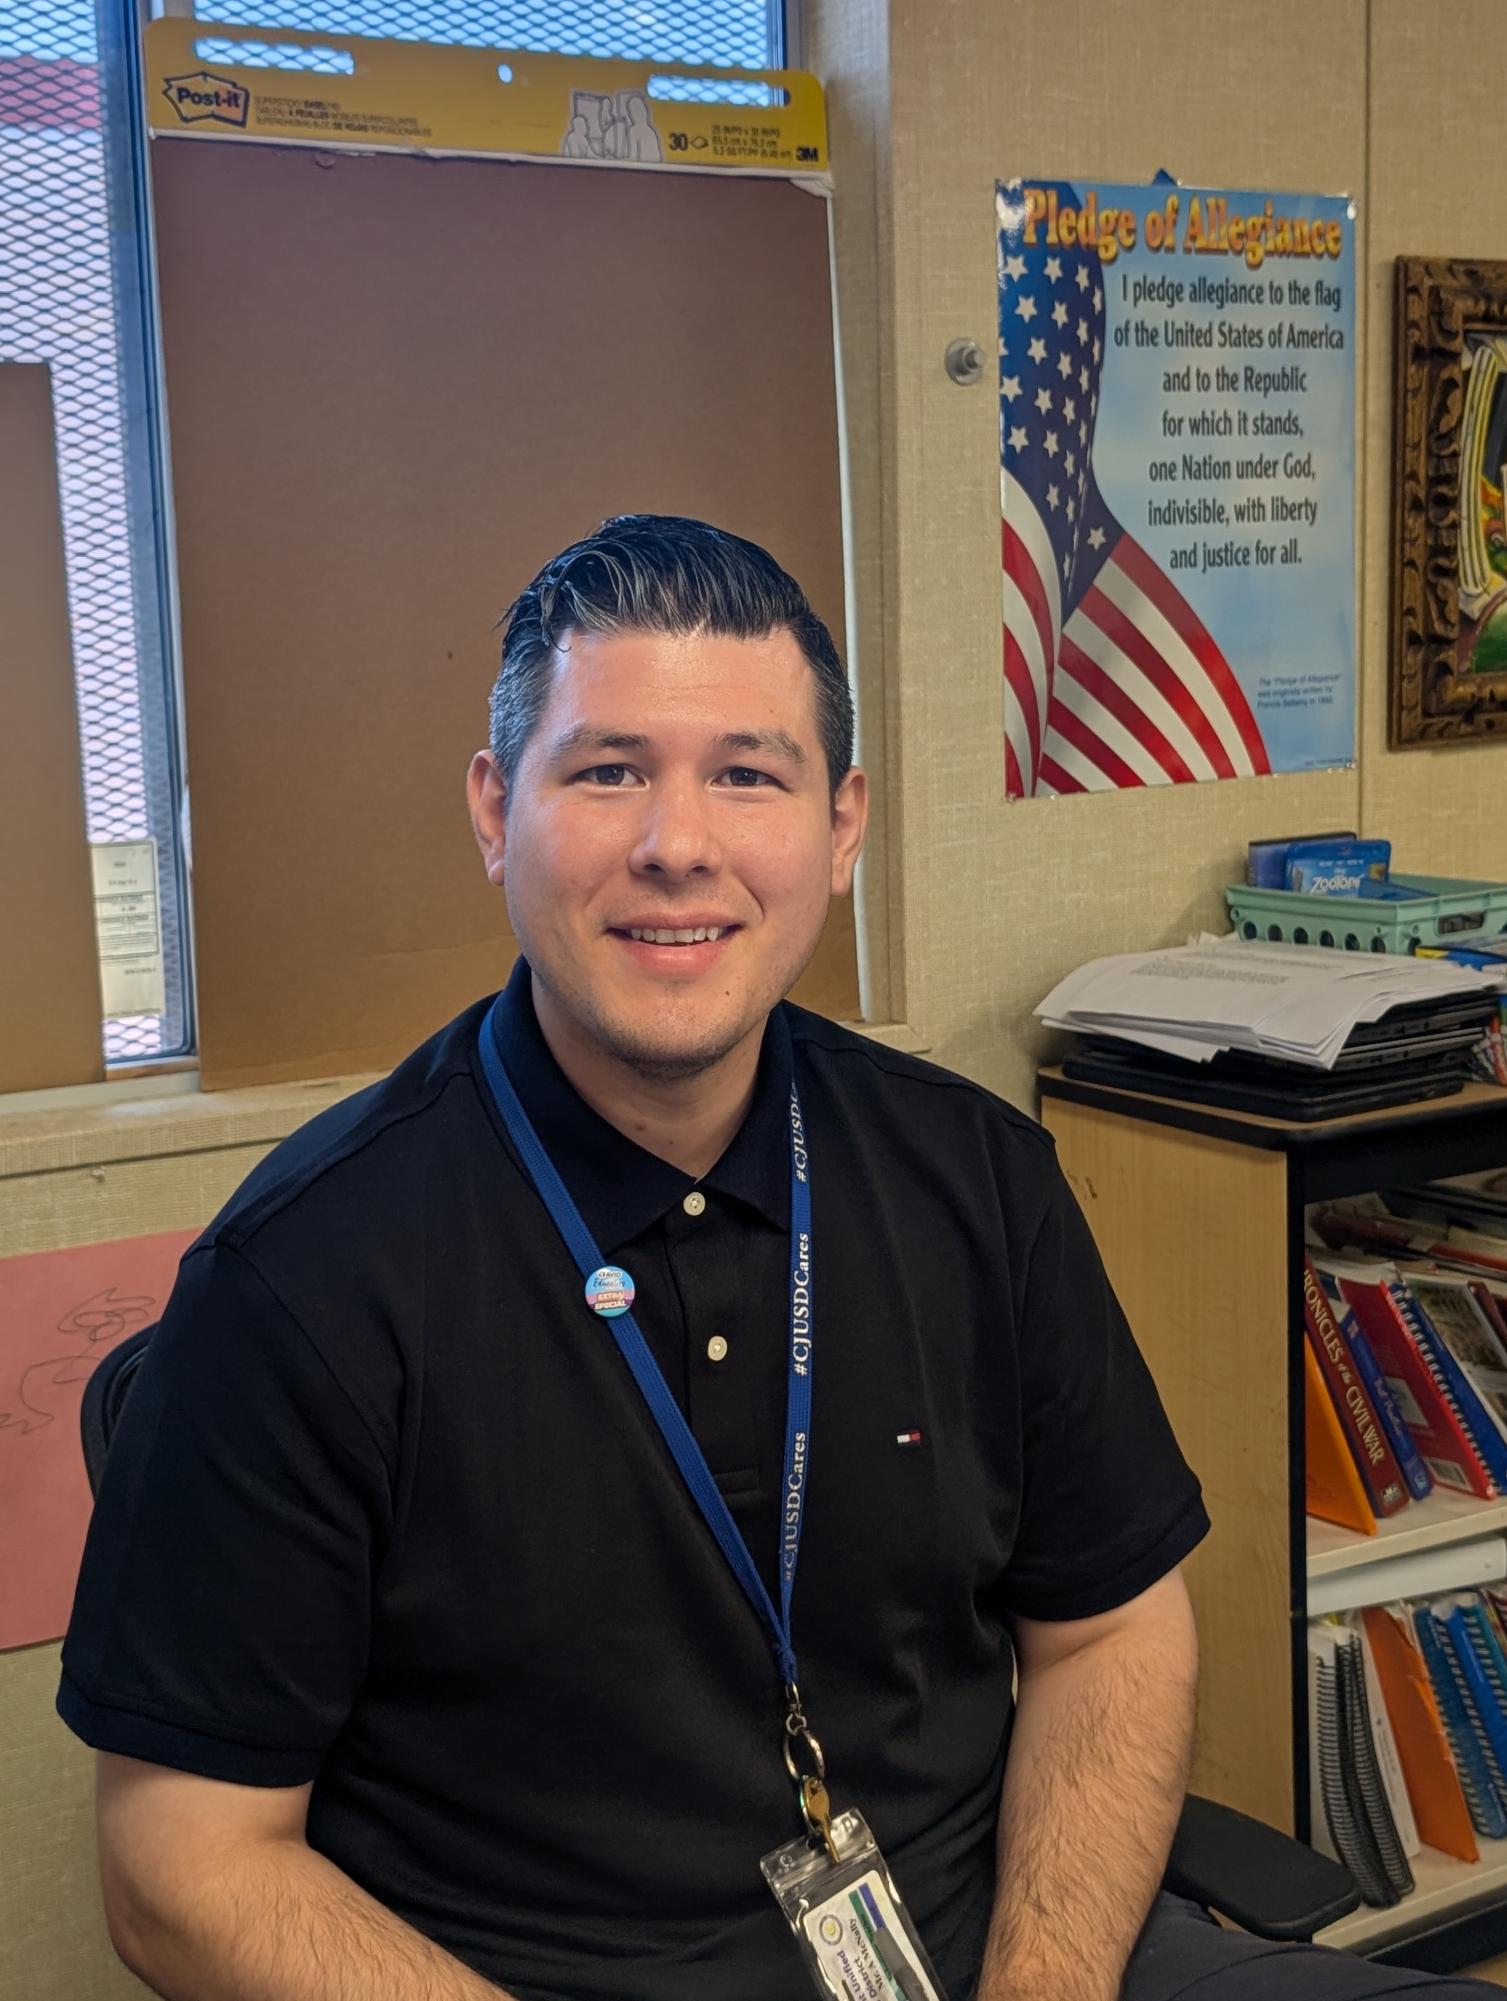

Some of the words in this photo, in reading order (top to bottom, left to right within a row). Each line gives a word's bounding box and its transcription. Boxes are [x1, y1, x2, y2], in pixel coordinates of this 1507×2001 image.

[177, 86, 242, 109] Post-it
[669, 133, 687, 150] 30
[796, 146, 818, 161] 3M
[1022, 188, 1137, 265] Pledge
[1145, 194, 1179, 249] of
[1183, 192, 1343, 269] Allegiance
[1122, 274, 1127, 301] I
[1132, 275, 1184, 307] pledge
[1189, 276, 1264, 309] allegiance
[1268, 282, 1284, 304] to
[1288, 279, 1311, 304] the
[1314, 280, 1342, 311] flag
[1114, 320, 1131, 347] of
[1135, 320, 1159, 347] the
[1164, 321, 1213, 348] United
[1217, 322, 1263, 348] States
[1268, 322, 1284, 348] of
[1286, 324, 1344, 350] America
[1163, 366, 1190, 392] and
[1196, 370, 1211, 392] to
[1215, 366, 1240, 392] the
[1244, 366, 1308, 398] Republic
[1162, 410, 1184, 436] for
[1189, 410, 1233, 436] which
[1237, 410, 1249, 436] it
[1252, 410, 1304, 438] stands,
[1149, 460, 1177, 481] one
[1182, 453, 1231, 481] Nation
[1236, 453, 1279, 479] under
[1283, 452, 1316, 482] God,
[1148, 498, 1230, 527] indivisible,
[1234, 497, 1267, 523] with
[1271, 496, 1318, 527] liberty
[1170, 542, 1198, 569] and
[1201, 541, 1250, 574] justice
[1255, 540, 1276, 565] for
[1280, 539, 1302, 565] all.
[793, 1232, 812, 1376] #CJUSDCares
[1304, 1271, 1344, 1362] RONICLES
[1346, 1386, 1371, 1434] CIVIL
[1363, 1423, 1385, 1466] WAR
[849, 1918, 872, 1961] McNally
[837, 1950, 861, 1992] Unified
[854, 1955, 878, 1998] District
